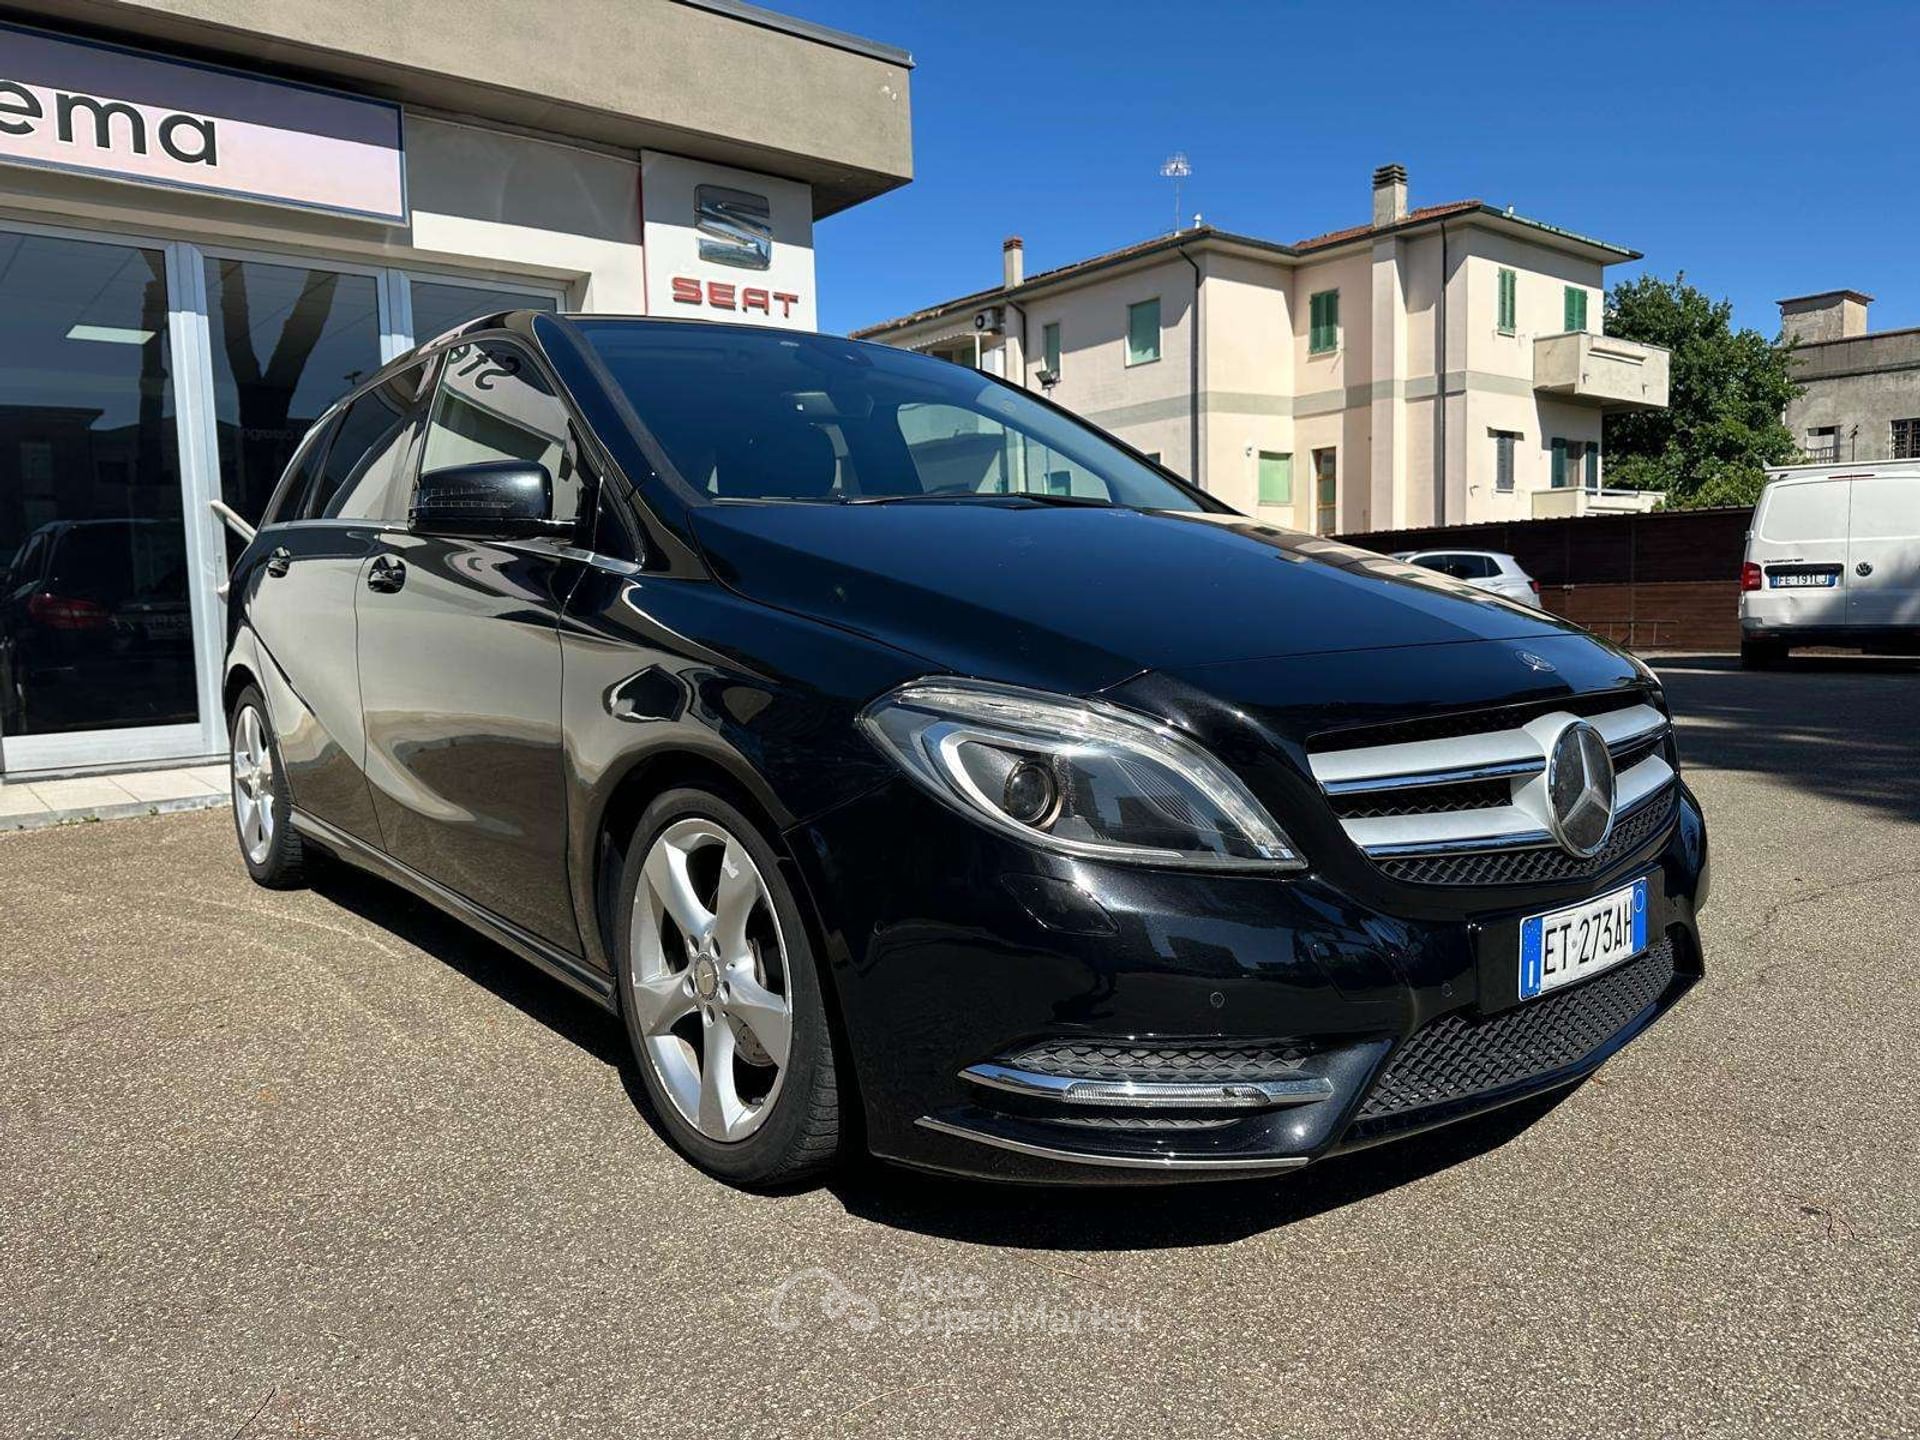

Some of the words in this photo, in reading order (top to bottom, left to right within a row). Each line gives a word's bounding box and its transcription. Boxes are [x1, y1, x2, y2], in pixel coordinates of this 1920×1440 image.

[0, 80, 217, 166] ema
[672, 277, 799, 318] SEAT
[1543, 923, 1572, 976] ET
[1578, 899, 1633, 965] 273AH
